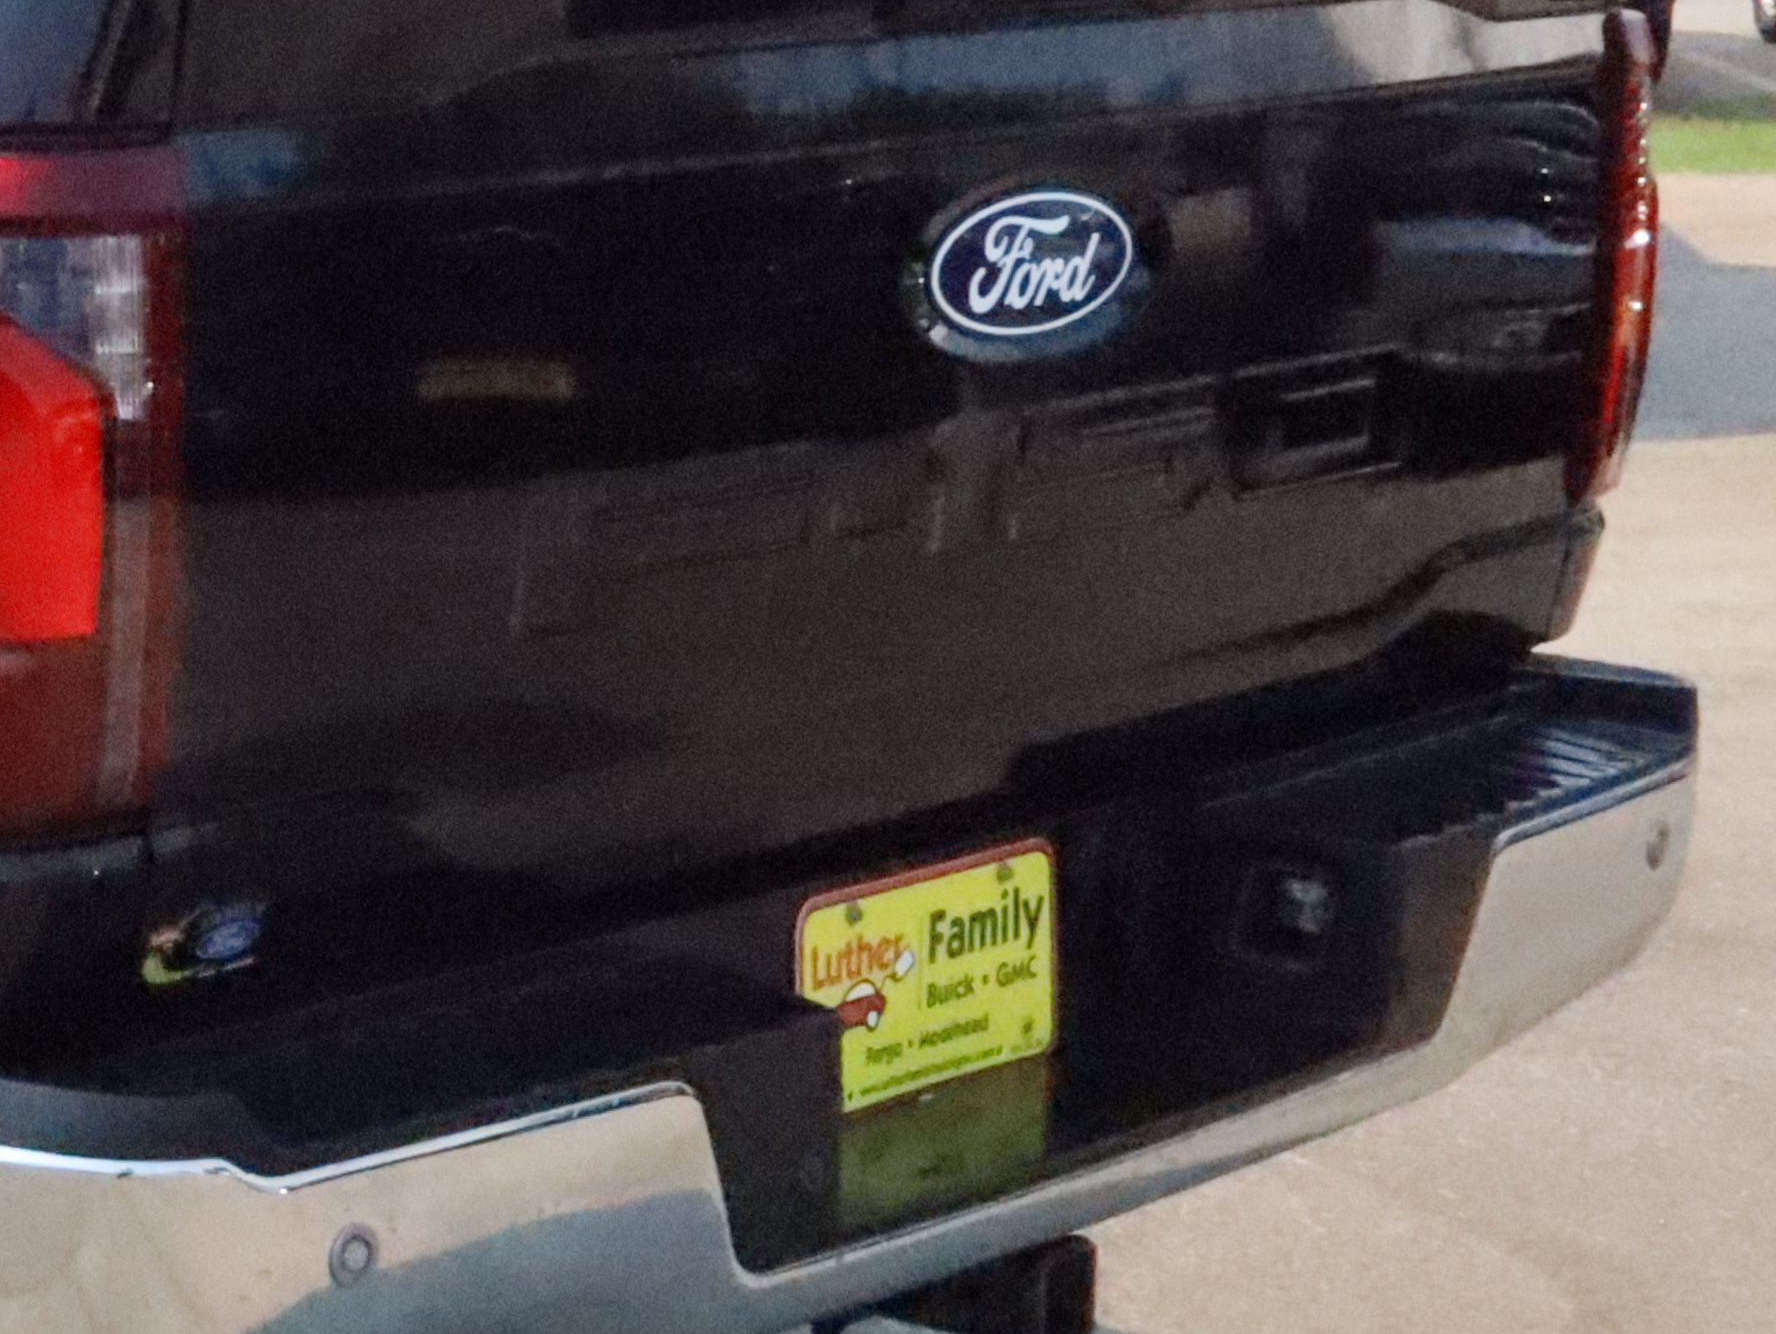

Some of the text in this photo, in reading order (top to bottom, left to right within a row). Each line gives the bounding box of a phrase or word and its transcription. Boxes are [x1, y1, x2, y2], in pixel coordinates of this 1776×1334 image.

[968, 214, 1101, 314] Ford
[811, 886, 1045, 990] Luther Family
[926, 954, 1038, 1008] Buick GMC
